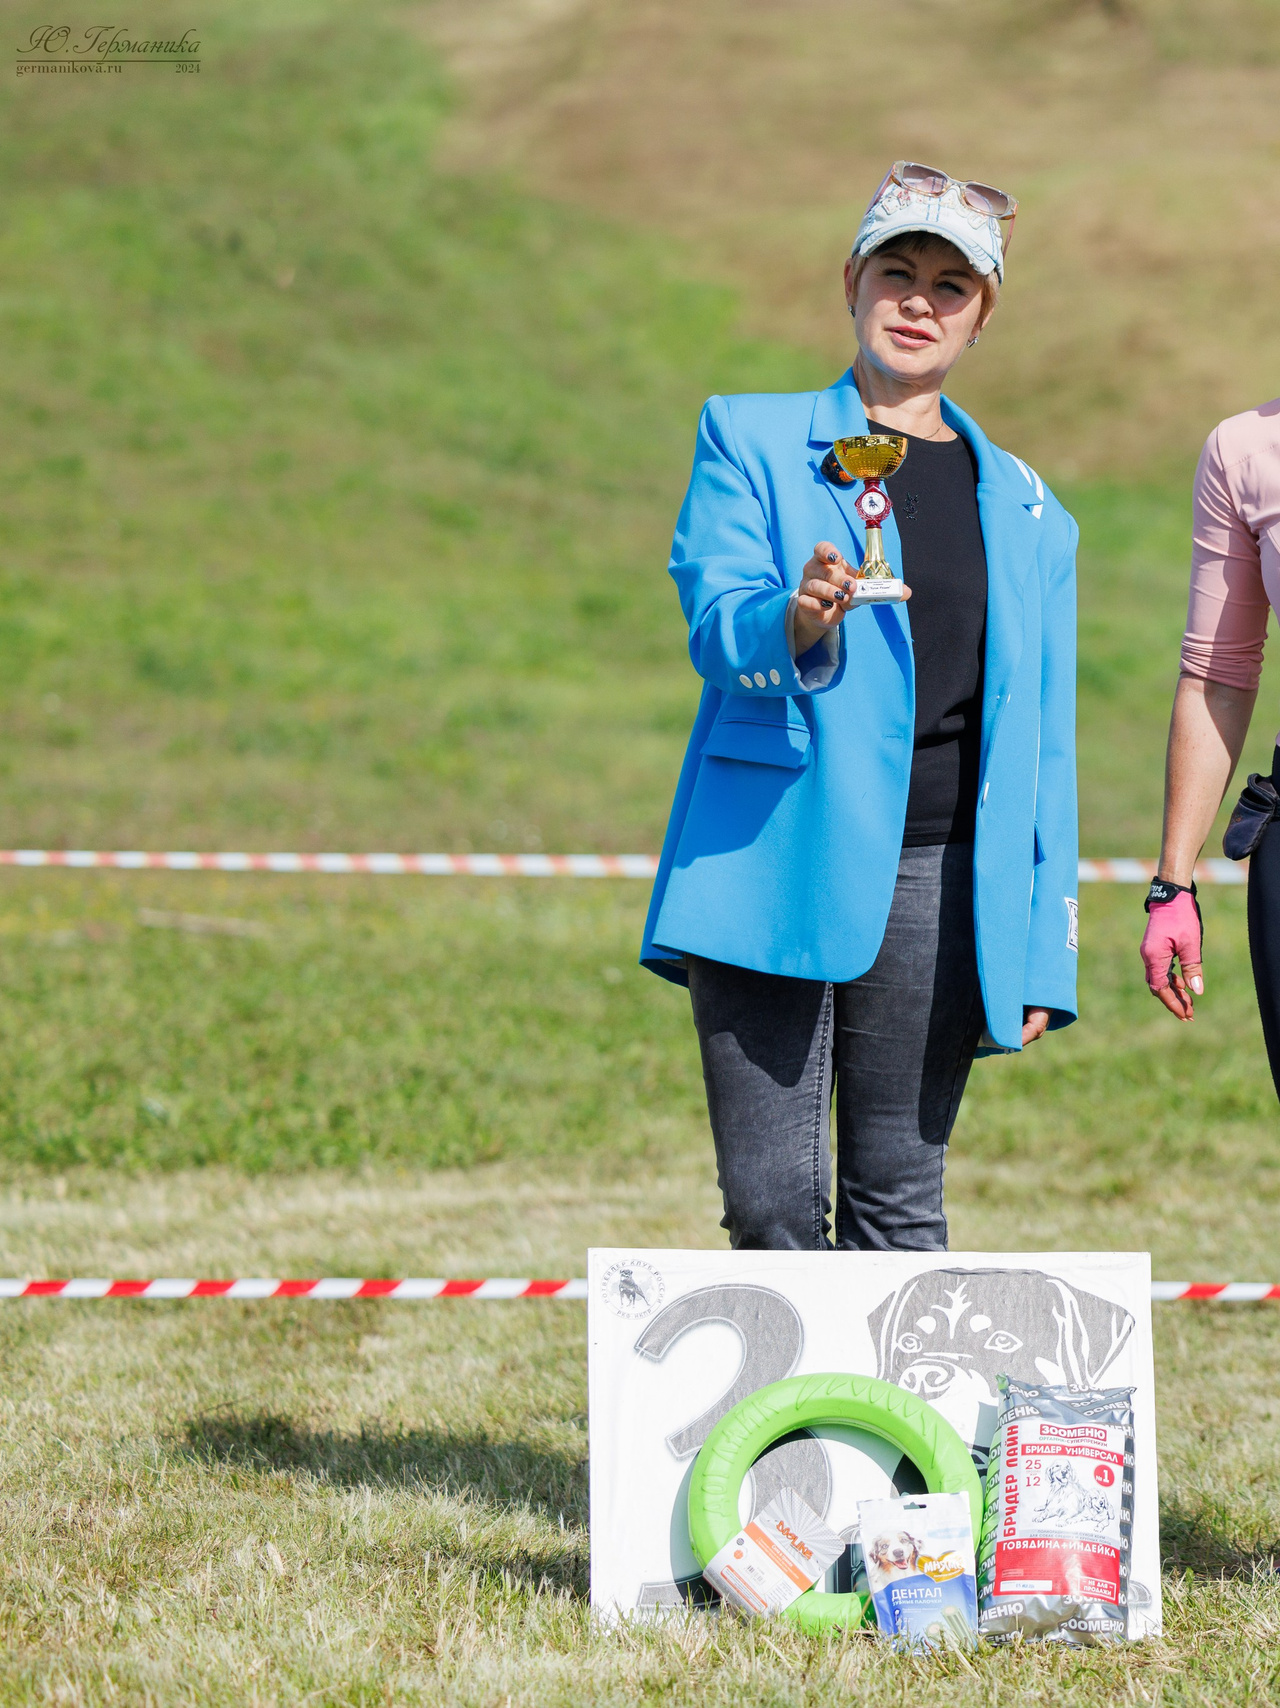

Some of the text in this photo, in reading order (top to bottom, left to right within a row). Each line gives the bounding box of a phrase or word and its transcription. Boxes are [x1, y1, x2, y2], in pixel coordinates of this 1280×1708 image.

[1041, 1425, 1106, 1440] ЗООМЕНЮ
[1025, 1445, 1118, 1463] БРИДЕР УНИВЕРСАЛ
[1025, 1460, 1042, 1470] 25
[1003, 1425, 1019, 1537] БРИДЕР ЛАЙН
[1025, 1476, 1041, 1487] 12
[891, 1587, 942, 1601] ДЕНТАЛ
[1084, 1585, 1111, 1596] ПРОДАЖИ
